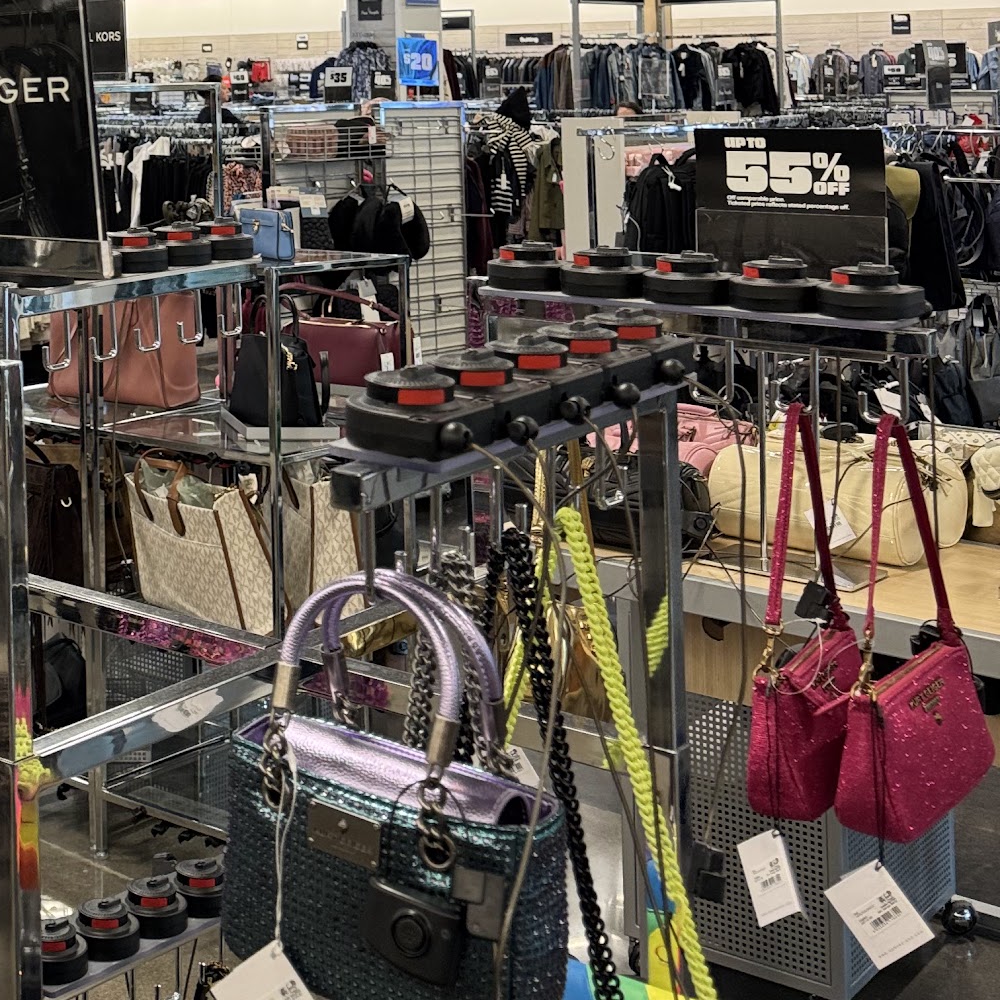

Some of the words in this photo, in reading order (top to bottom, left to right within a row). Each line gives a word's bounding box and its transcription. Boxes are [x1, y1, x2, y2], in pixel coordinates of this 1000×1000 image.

[95, 31, 121, 42] KORS
[403, 53, 433, 71] $20
[330, 72, 347, 83] $35
[724, 137, 746, 149] UP
[746, 137, 766, 149] TO
[726, 151, 850, 194] 55%
[813, 181, 850, 196] OFF
